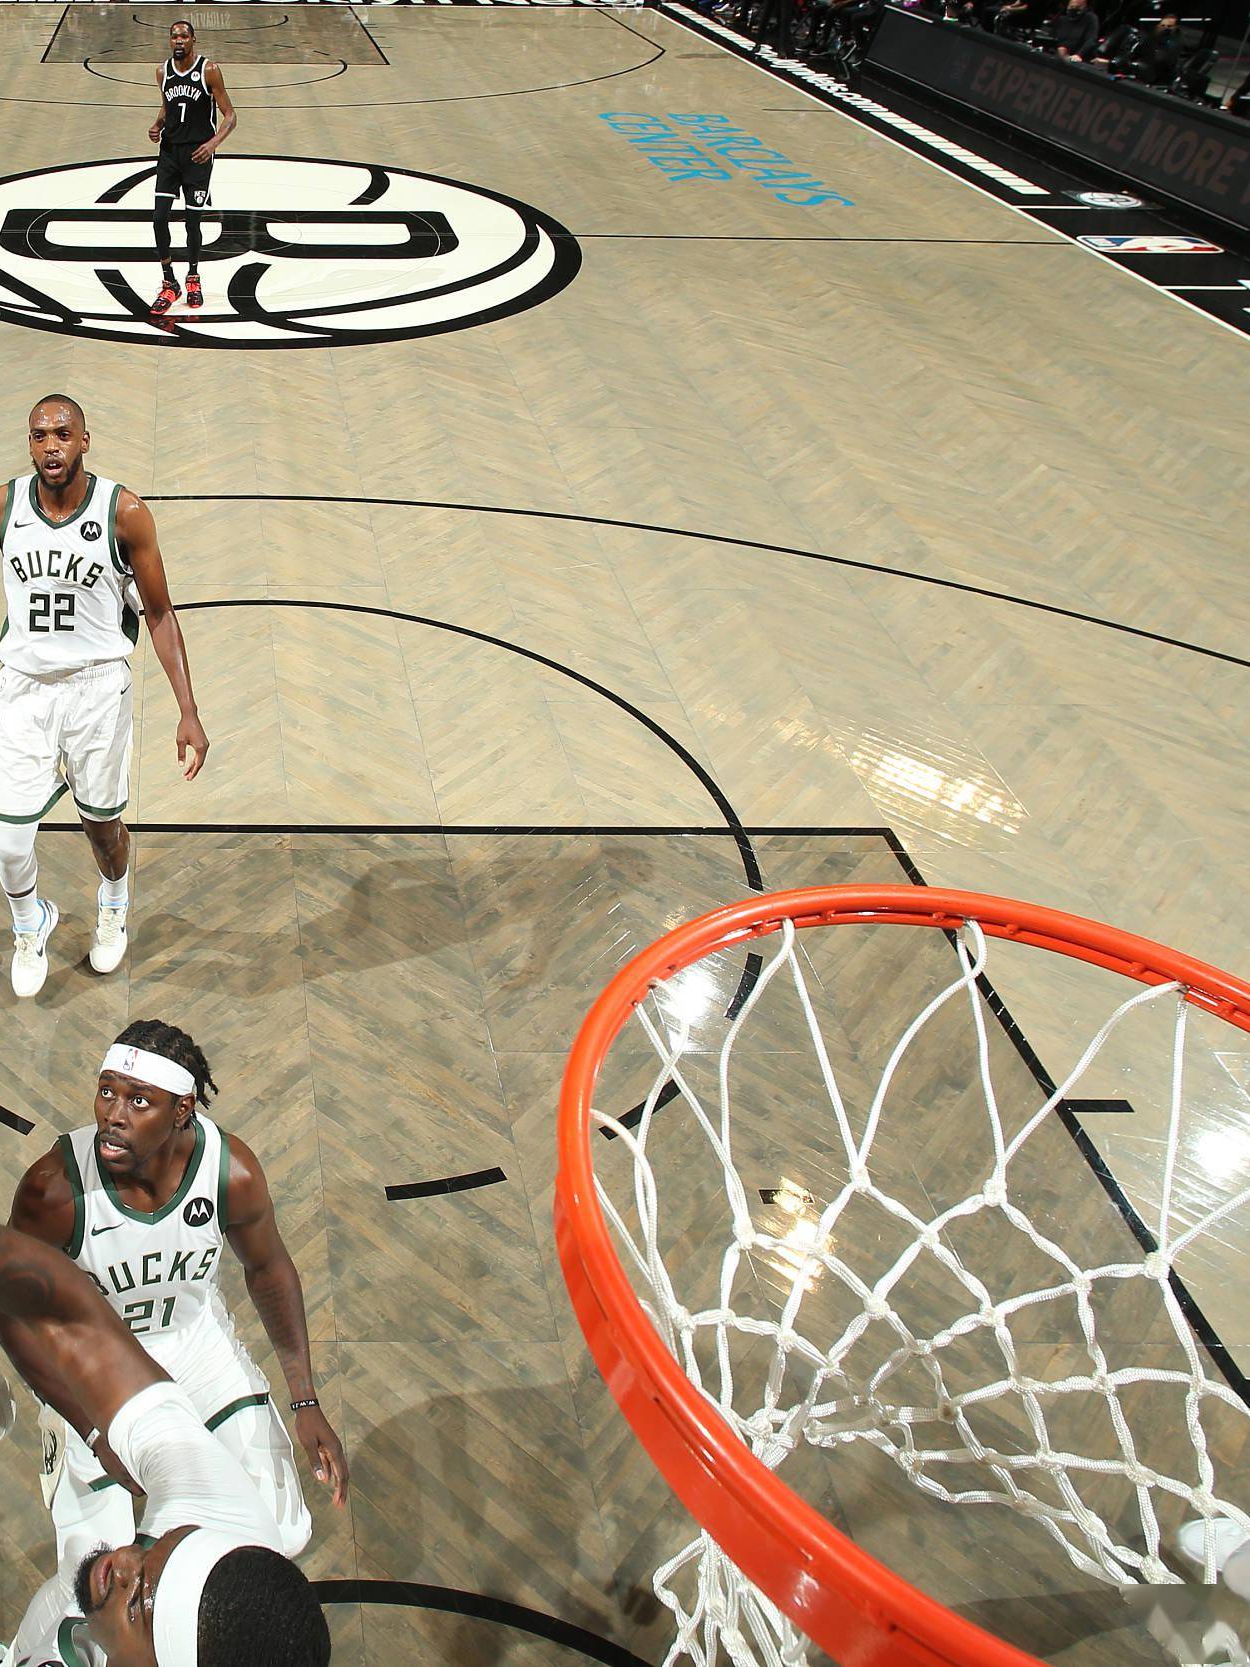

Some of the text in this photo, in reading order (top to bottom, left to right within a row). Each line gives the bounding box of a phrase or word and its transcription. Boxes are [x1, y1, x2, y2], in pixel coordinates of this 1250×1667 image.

[165, 84, 202, 102] BROOKLYN
[178, 103, 187, 123] 7
[970, 56, 1249, 193] EXPERIENCE MORE
[597, 111, 734, 182] CENTER
[668, 113, 857, 208] BARCLAYS
[10, 549, 104, 588] BUCKS
[29, 593, 76, 632] 22
[123, 1295, 177, 1334] 21
